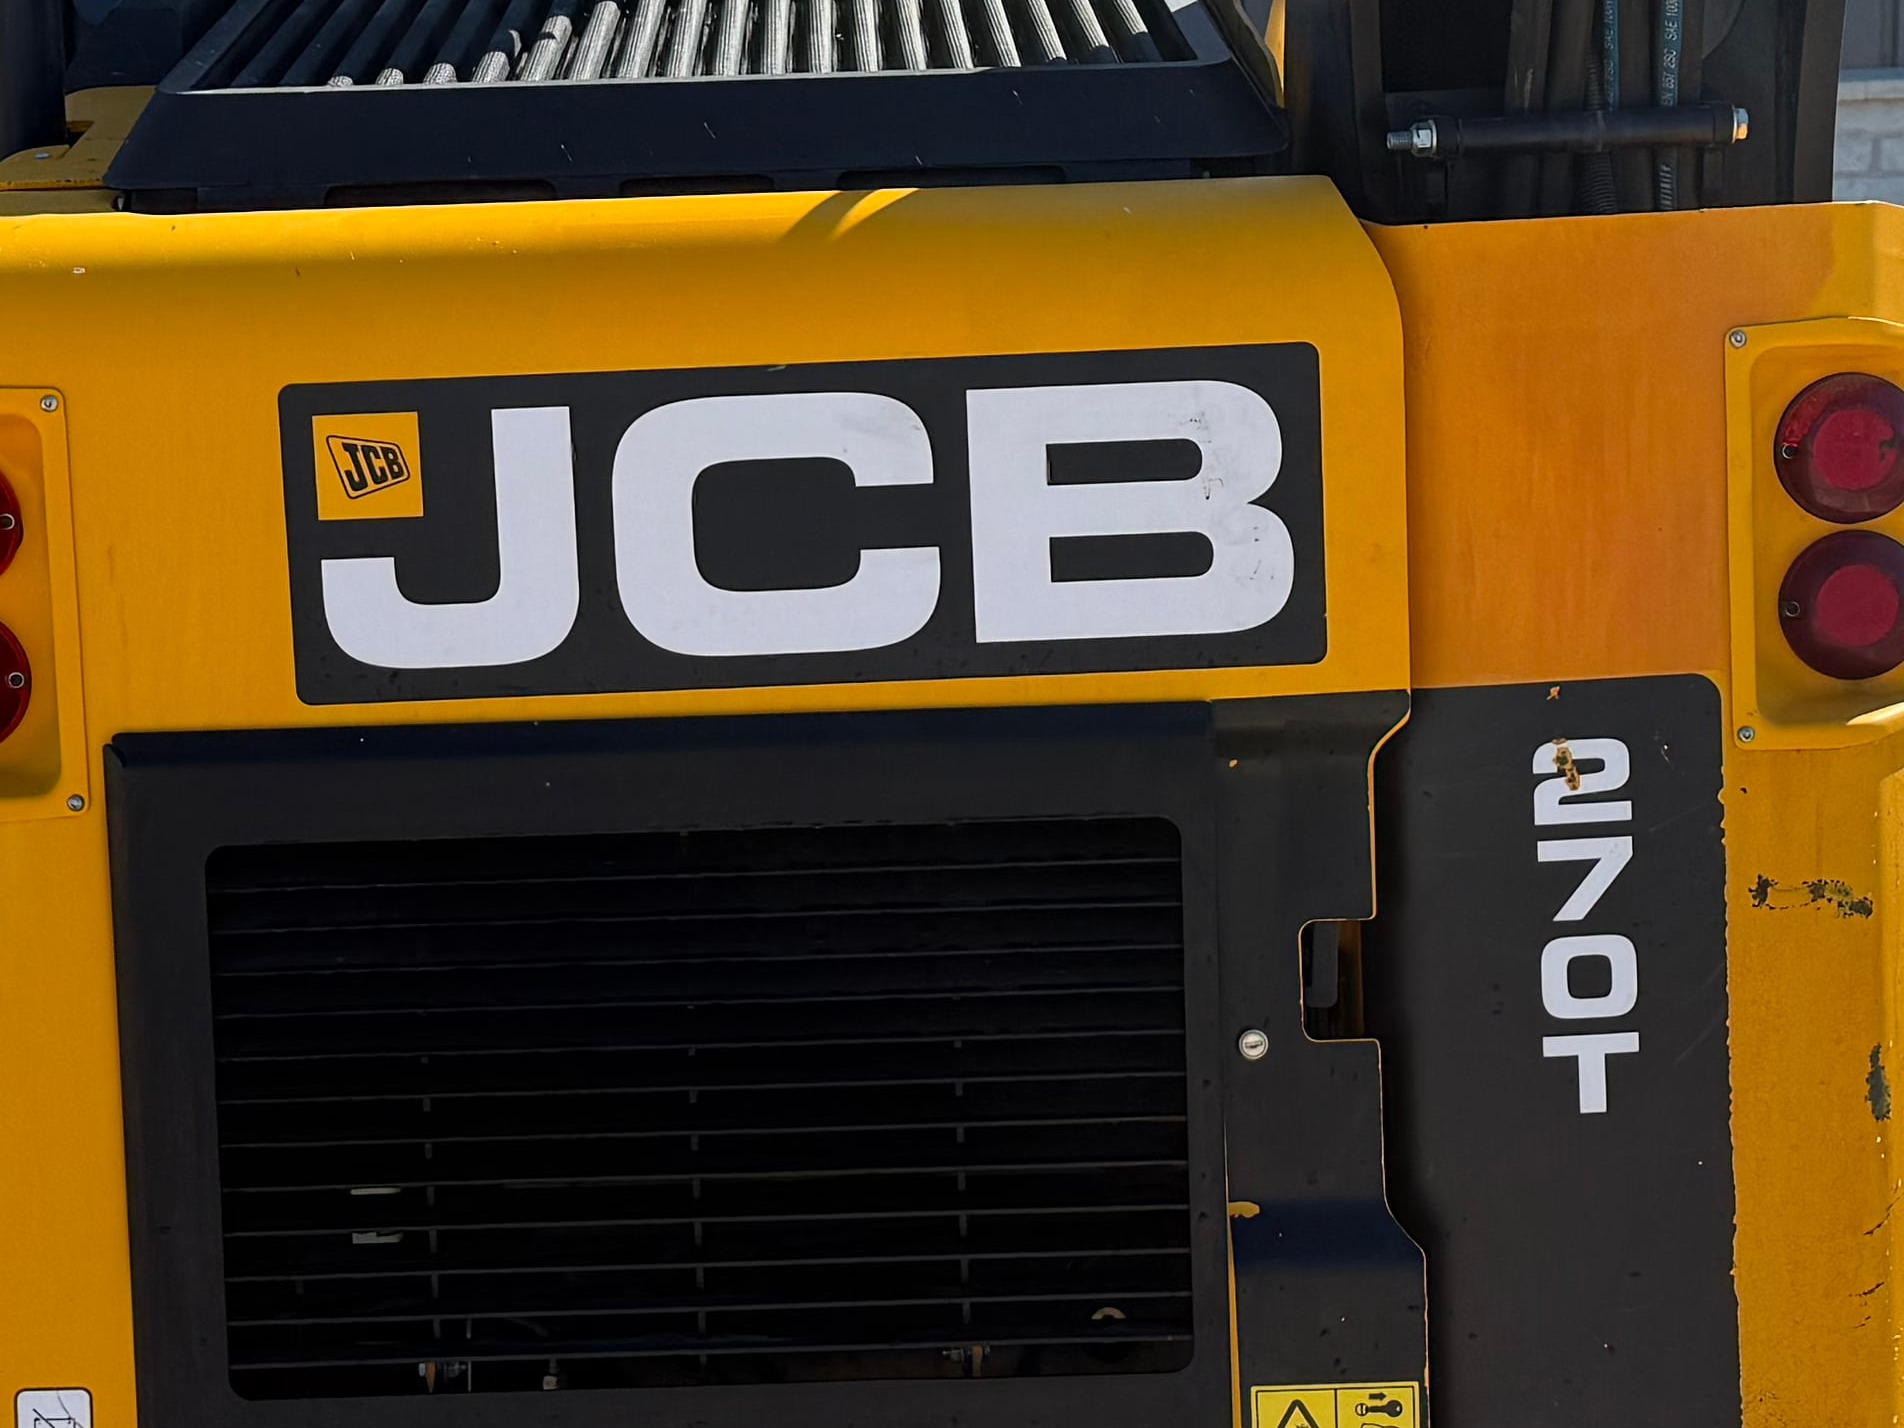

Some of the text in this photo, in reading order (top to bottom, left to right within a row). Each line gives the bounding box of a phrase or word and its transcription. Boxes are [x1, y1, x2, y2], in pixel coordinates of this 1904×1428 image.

[1664, 19, 1678, 41] SAE
[321, 379, 1296, 669] JCB
[341, 442, 405, 492] JCB
[1532, 737, 1640, 1114] 270T
